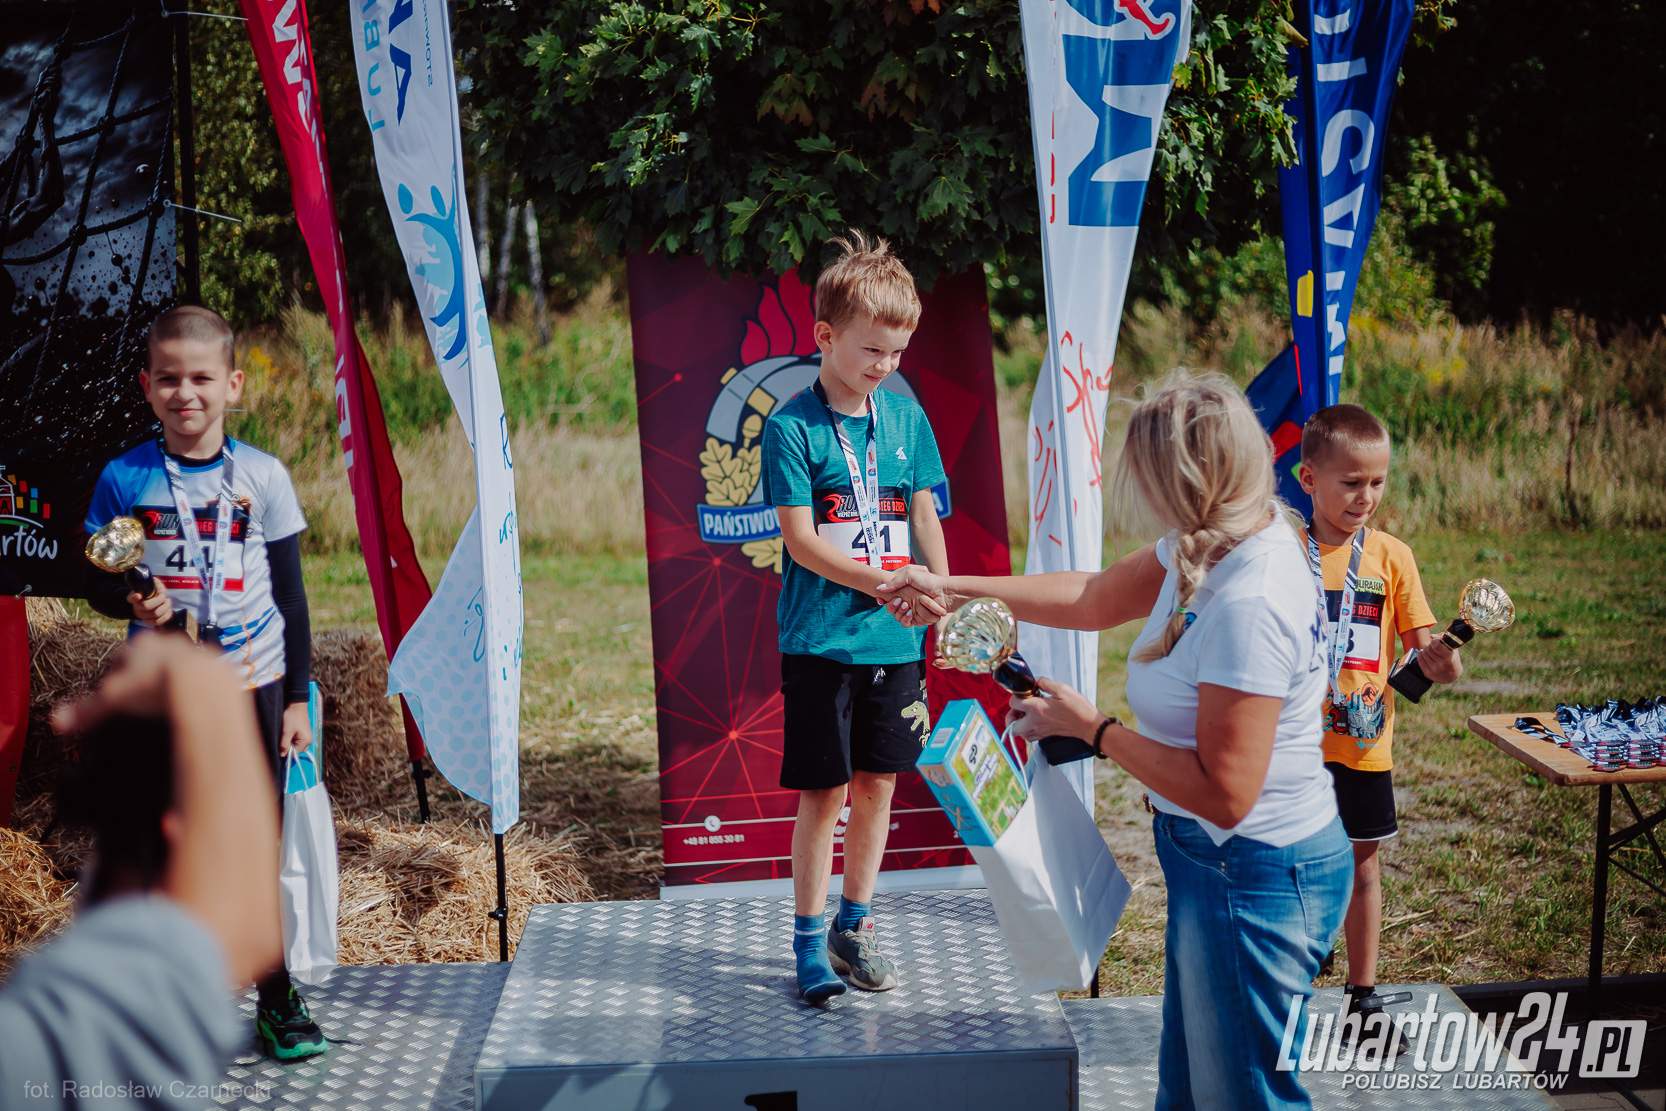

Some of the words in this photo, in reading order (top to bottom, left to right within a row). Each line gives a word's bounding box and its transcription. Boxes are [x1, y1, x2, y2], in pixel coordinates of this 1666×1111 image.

[0, 525, 58, 560] rtów
[851, 525, 891, 554] 41
[1358, 605, 1378, 617] DZIECI
